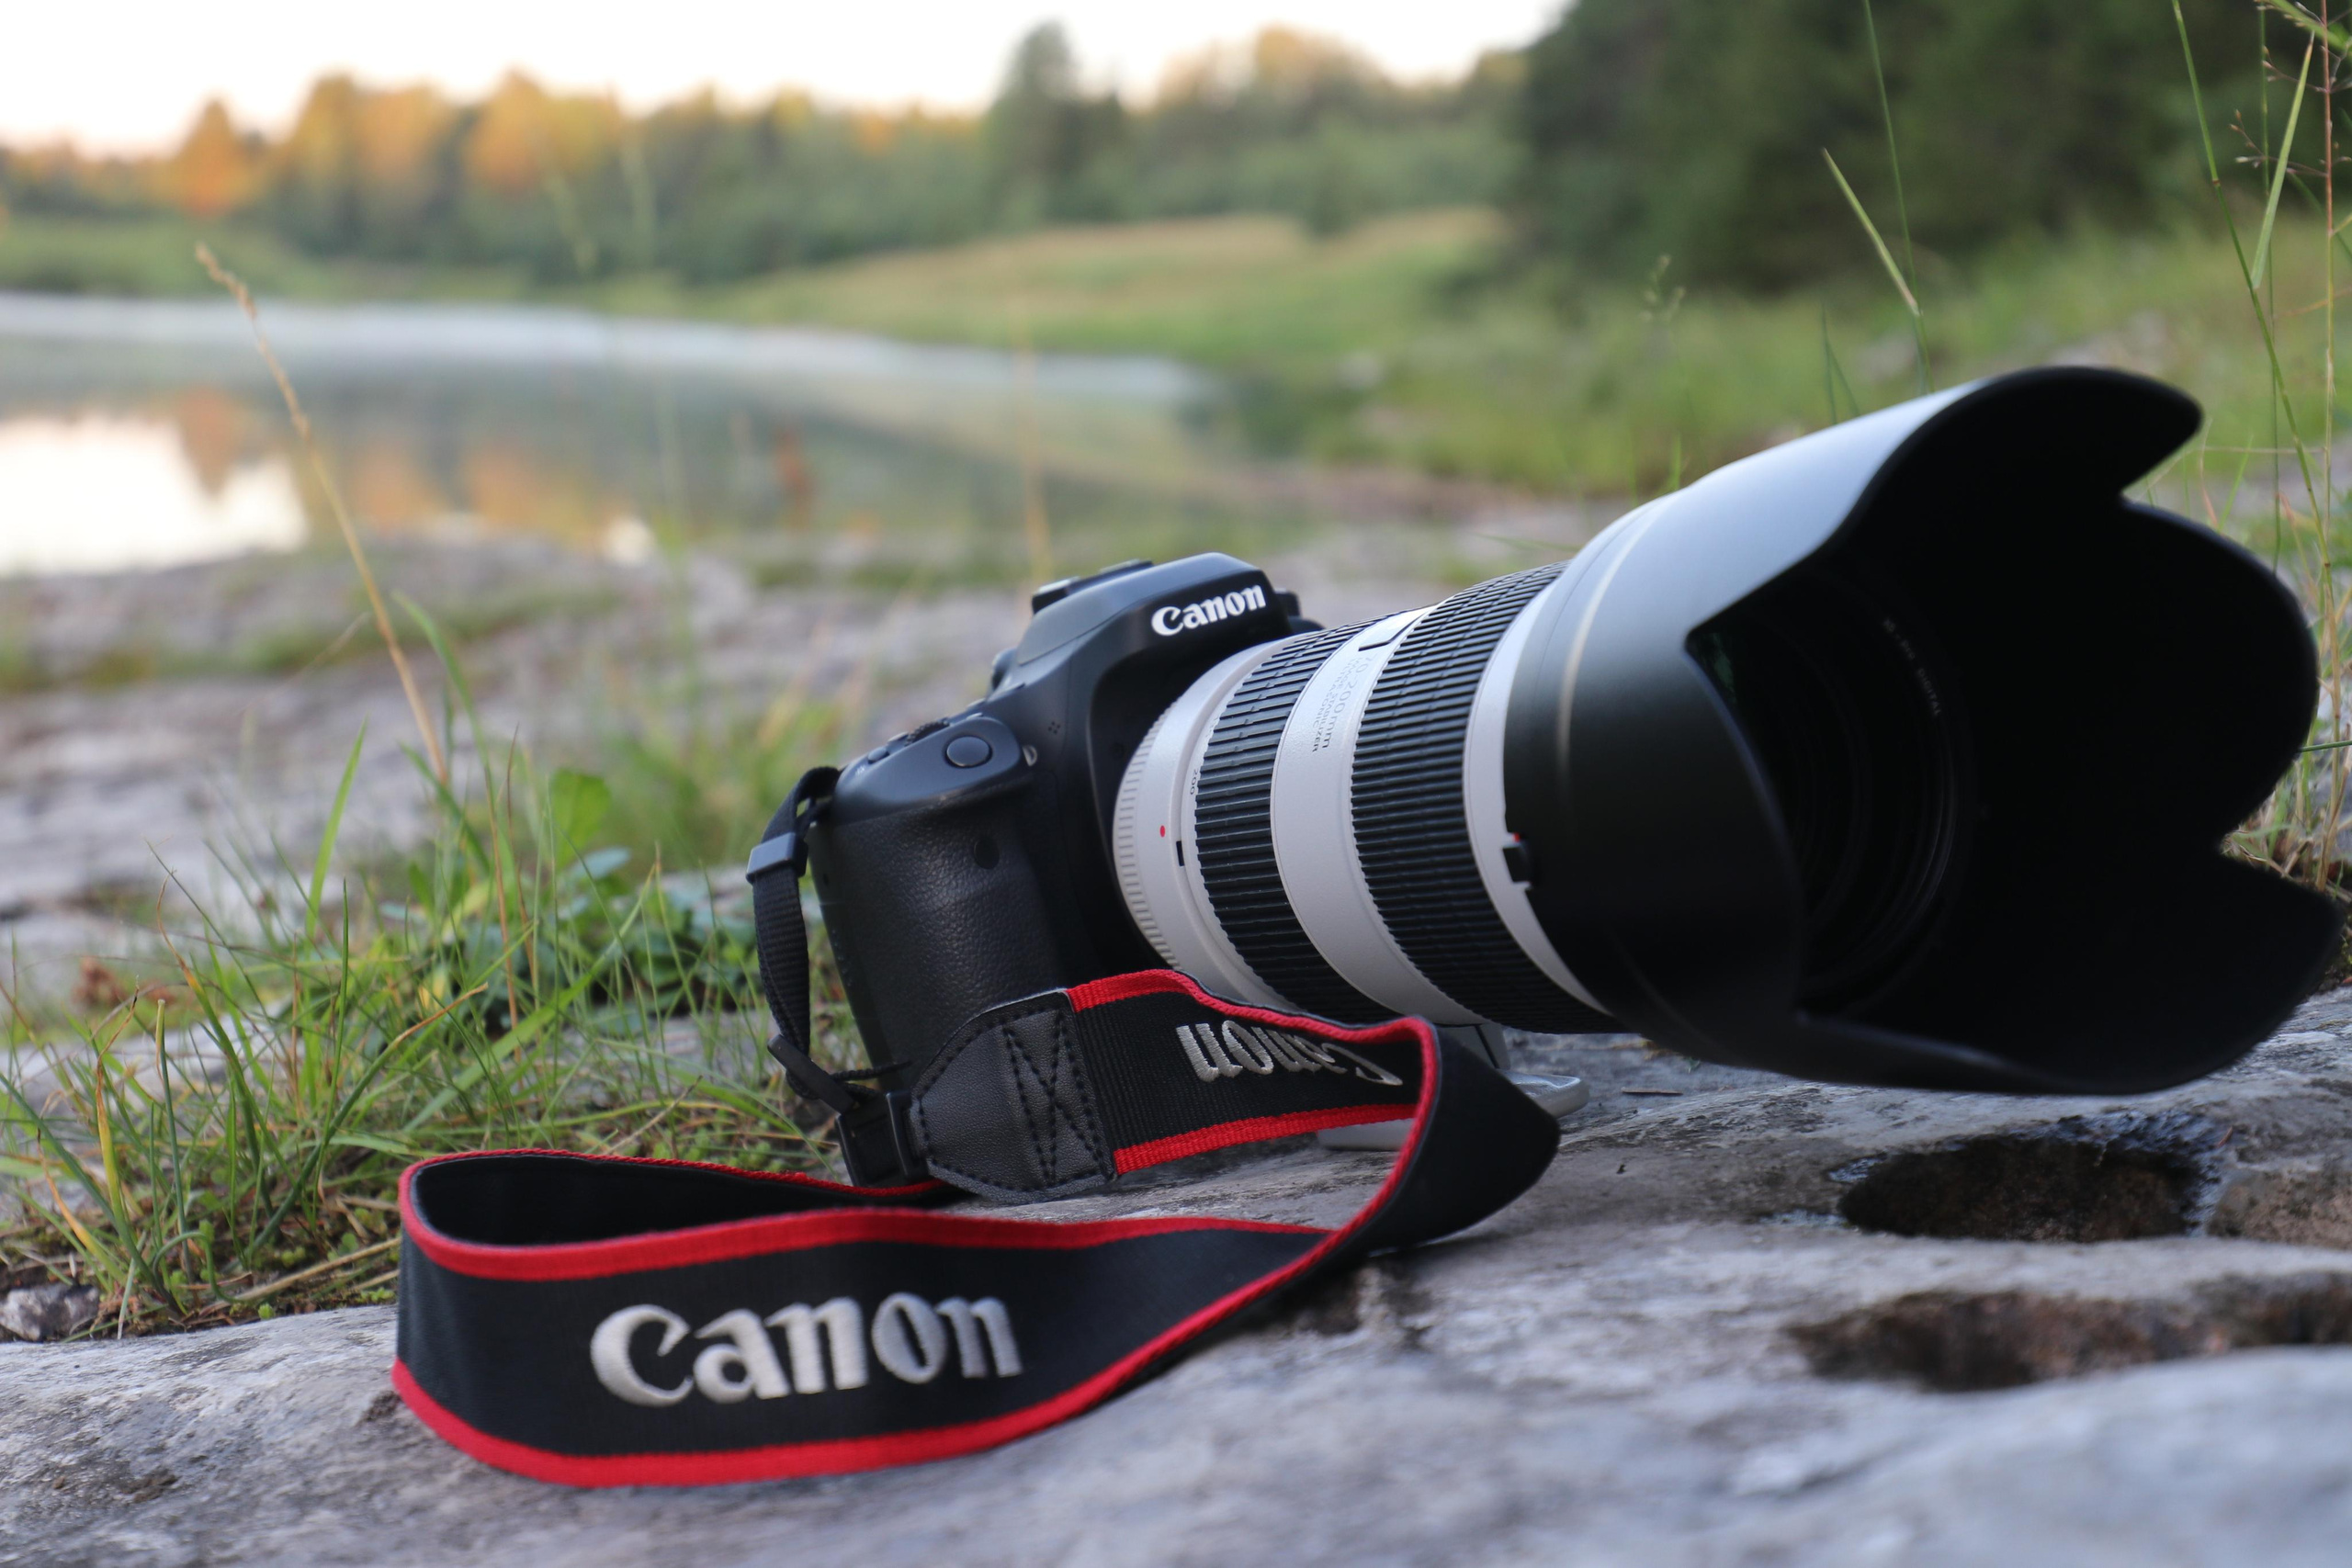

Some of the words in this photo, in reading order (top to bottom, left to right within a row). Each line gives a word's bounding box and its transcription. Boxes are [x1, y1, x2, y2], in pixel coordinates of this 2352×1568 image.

[1151, 584, 1267, 637] Canon
[1311, 692, 1339, 753] STABILIZER
[1176, 1020, 1404, 1086] Canon
[590, 1292, 1023, 1407] Canon
